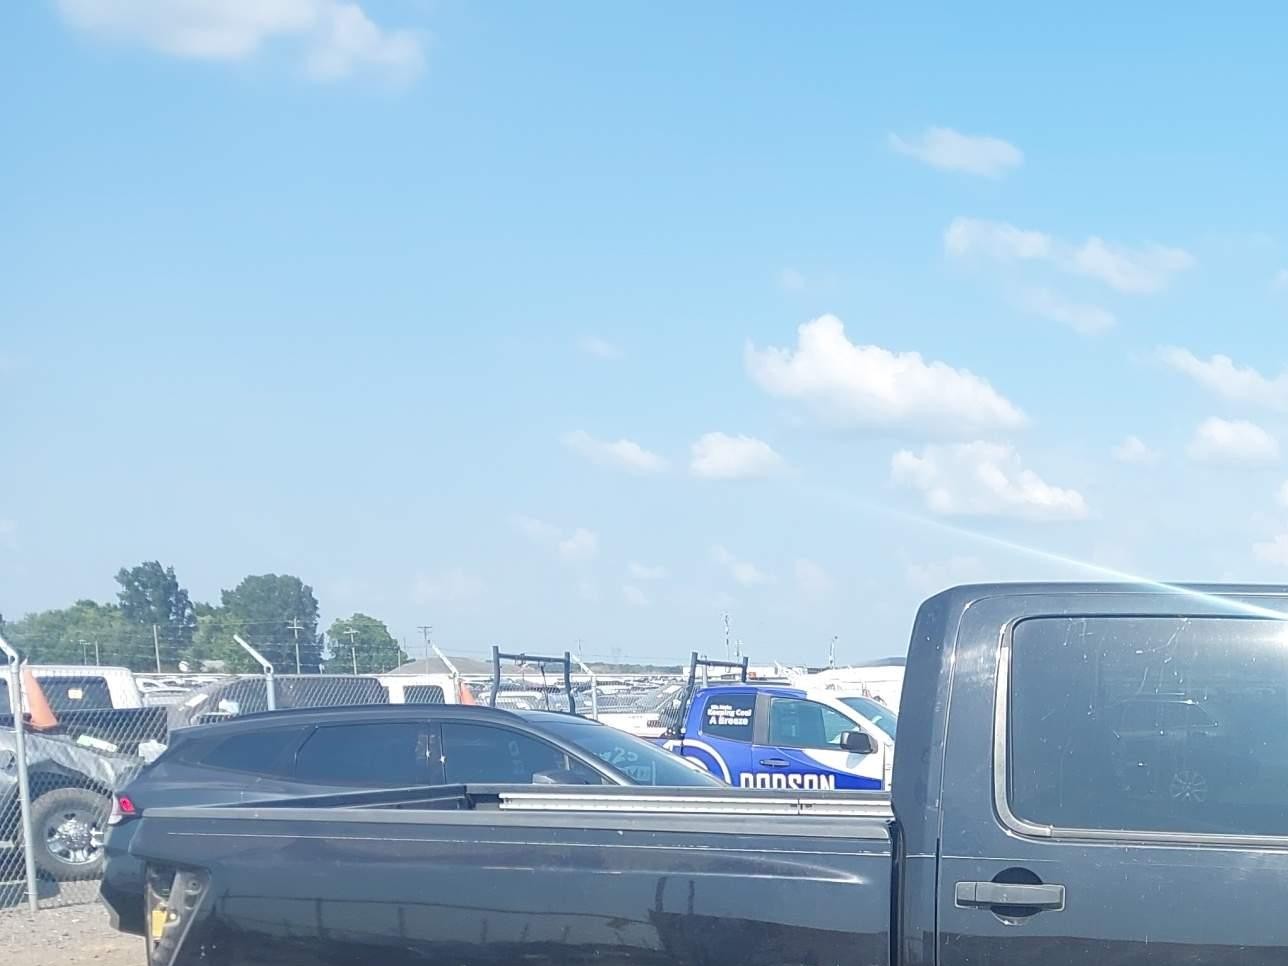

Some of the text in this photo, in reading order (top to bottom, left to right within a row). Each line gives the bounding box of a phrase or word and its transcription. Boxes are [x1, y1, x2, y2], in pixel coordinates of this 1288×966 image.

[707, 708, 752, 717] Keeping Cool
[709, 716, 749, 726] A Breeze
